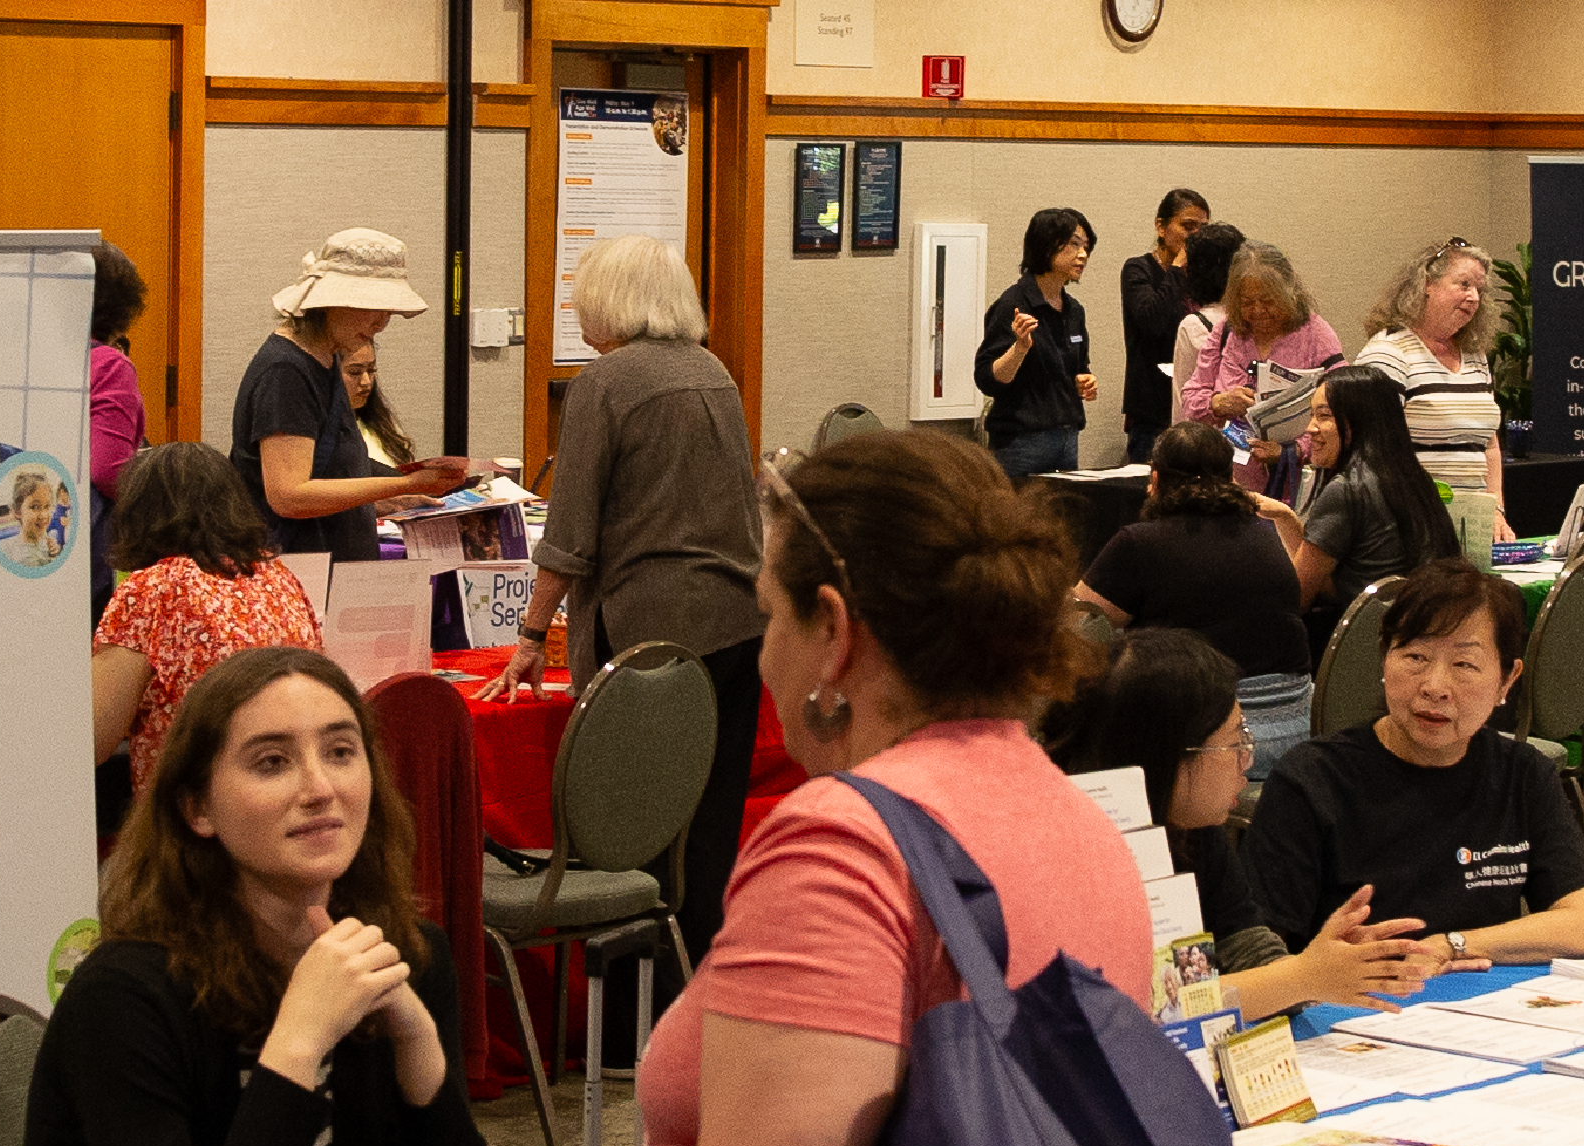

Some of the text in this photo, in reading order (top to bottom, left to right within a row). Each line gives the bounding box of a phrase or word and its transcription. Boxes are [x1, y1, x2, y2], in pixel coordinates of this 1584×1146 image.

[493, 572, 536, 604] Proje
[491, 602, 525, 627] Ser
[1473, 852, 1481, 860] El
